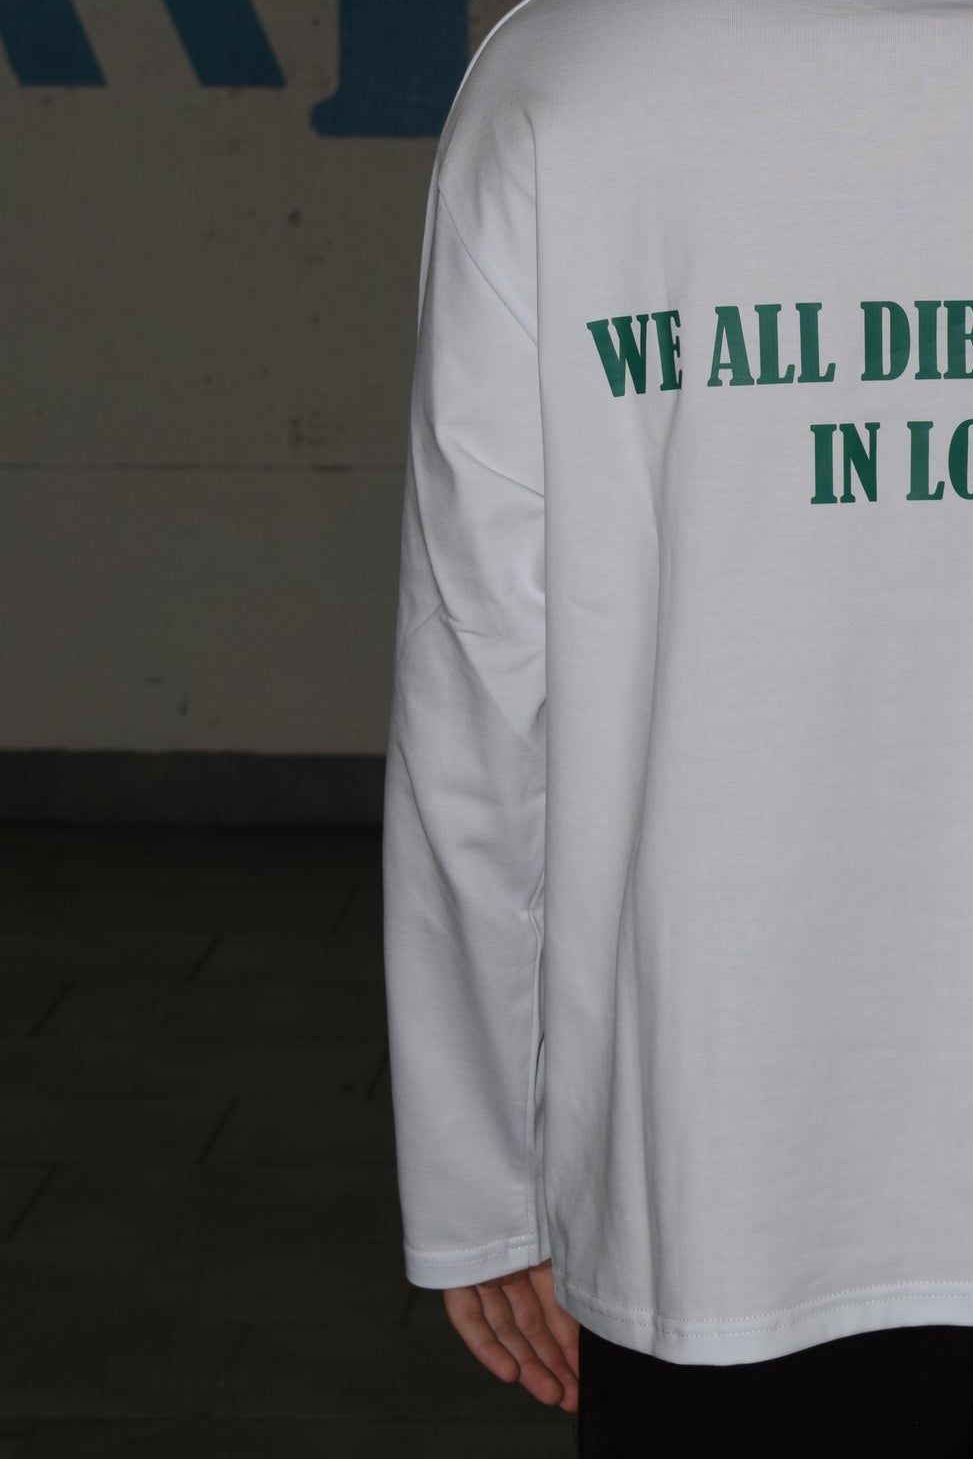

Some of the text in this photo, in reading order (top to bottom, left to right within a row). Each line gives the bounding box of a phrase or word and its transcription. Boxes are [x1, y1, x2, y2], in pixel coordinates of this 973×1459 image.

[586, 309, 683, 397] WE
[707, 302, 836, 388] ALL
[810, 421, 881, 505] IN
